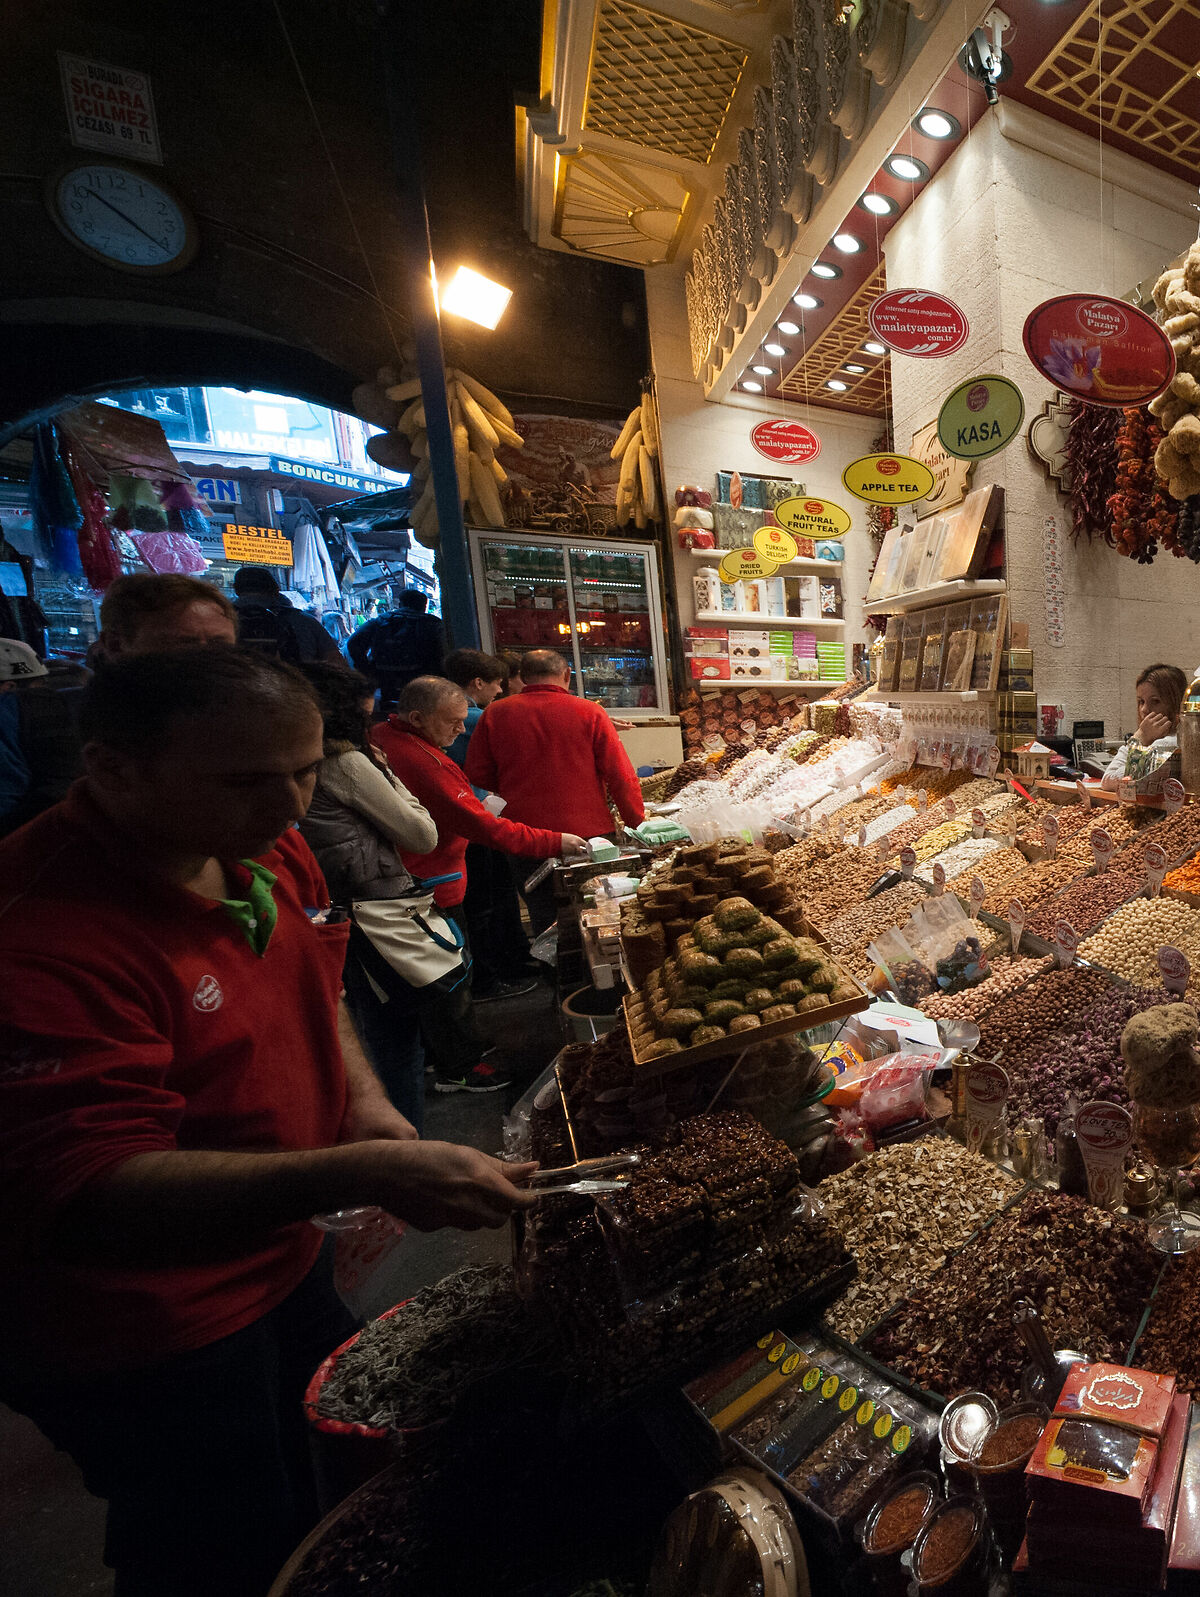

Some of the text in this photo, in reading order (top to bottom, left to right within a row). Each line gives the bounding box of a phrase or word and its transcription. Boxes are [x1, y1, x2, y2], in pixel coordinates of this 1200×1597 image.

[139, 130, 152, 144] TL
[875, 313, 900, 321] www.
[1083, 308, 1120, 323] Malatya
[880, 321, 961, 334] malatyapazari.
[1087, 317, 1119, 331] Pazarı
[927, 334, 953, 342] com.tr
[1113, 340, 1152, 353] Saffron
[957, 420, 1002, 447] KASA
[758, 439, 816, 450] malatyapazari.
[278, 460, 361, 492] BONCUK
[861, 483, 919, 493] APPLE TEA
[793, 513, 834, 525] NATURAL
[226, 523, 287, 540] BESTEL
[787, 520, 839, 534] FRUIT TEAS
[765, 543, 788, 552] TURKISH
[766, 550, 788, 559] DELIGHT
[1082, 1116, 1130, 1129] LOVE TEA
